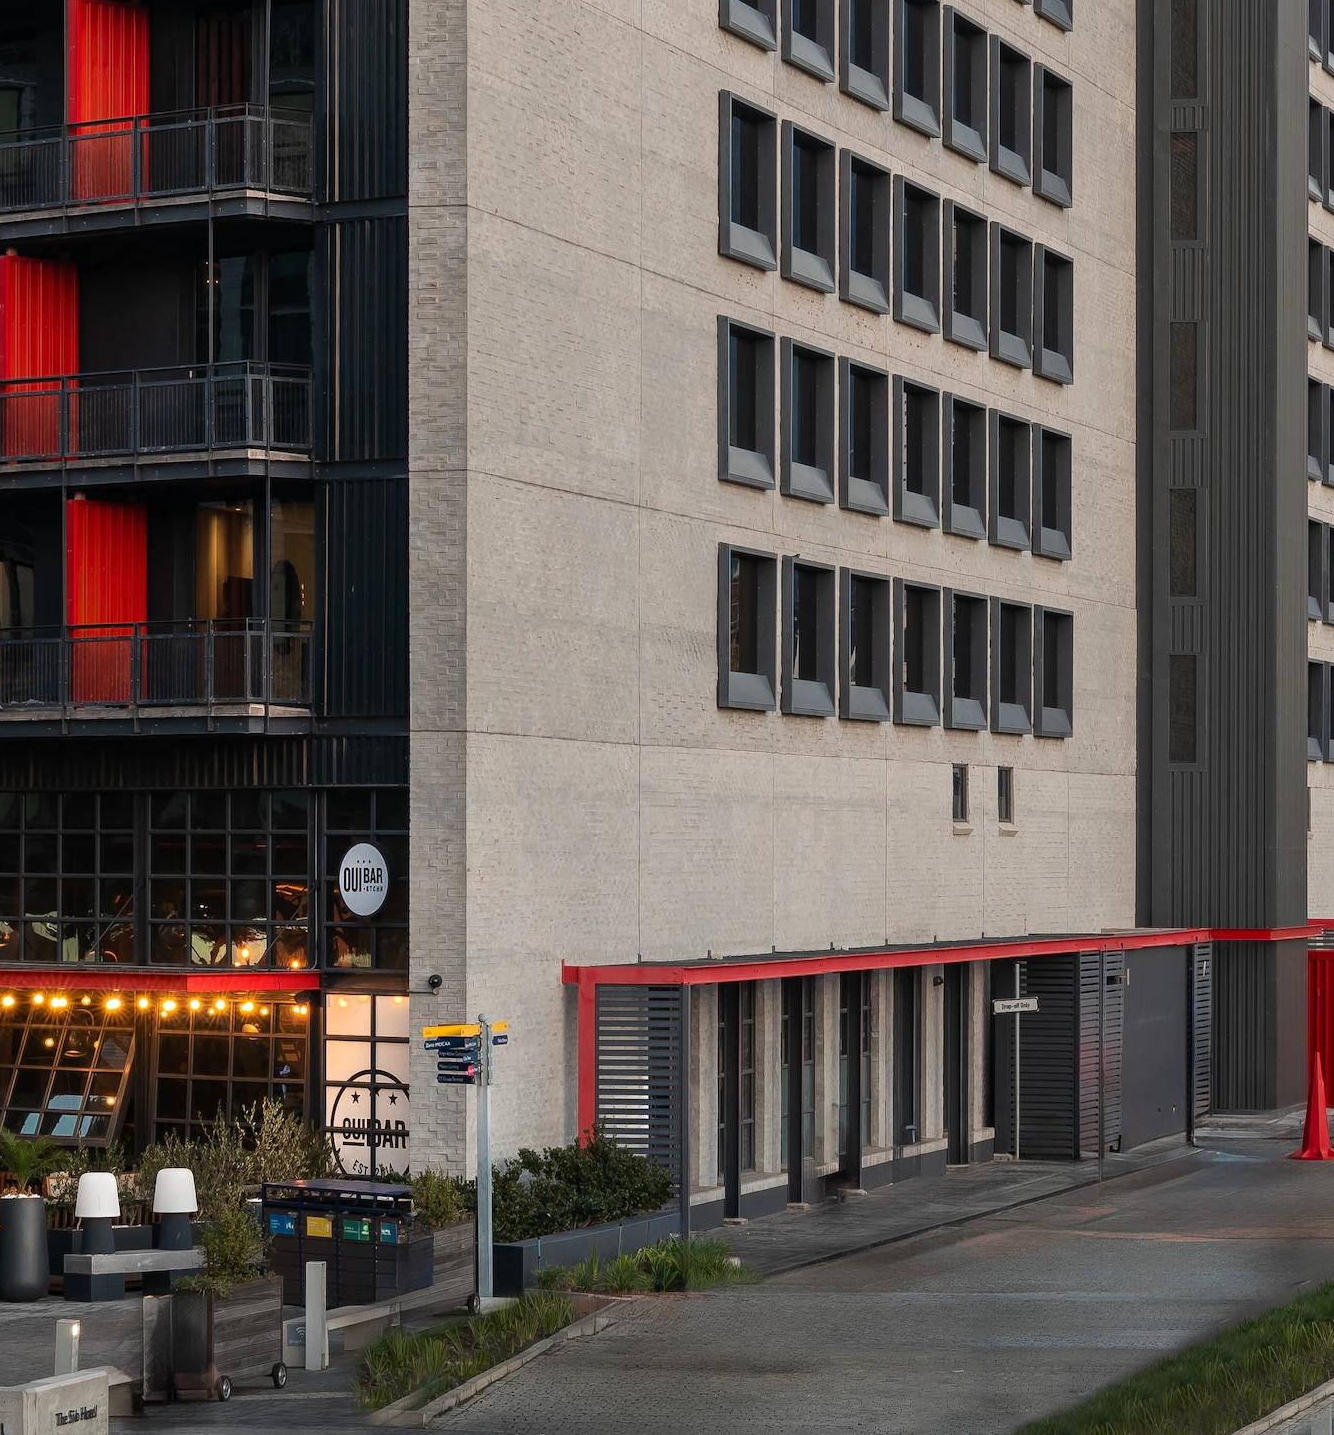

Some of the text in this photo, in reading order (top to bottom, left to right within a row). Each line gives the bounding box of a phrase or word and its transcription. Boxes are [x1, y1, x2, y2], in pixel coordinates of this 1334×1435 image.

[344, 867, 383, 892] OUI BAR
[352, 1159, 368, 1175] EST
[55, 1412, 68, 1426] The
